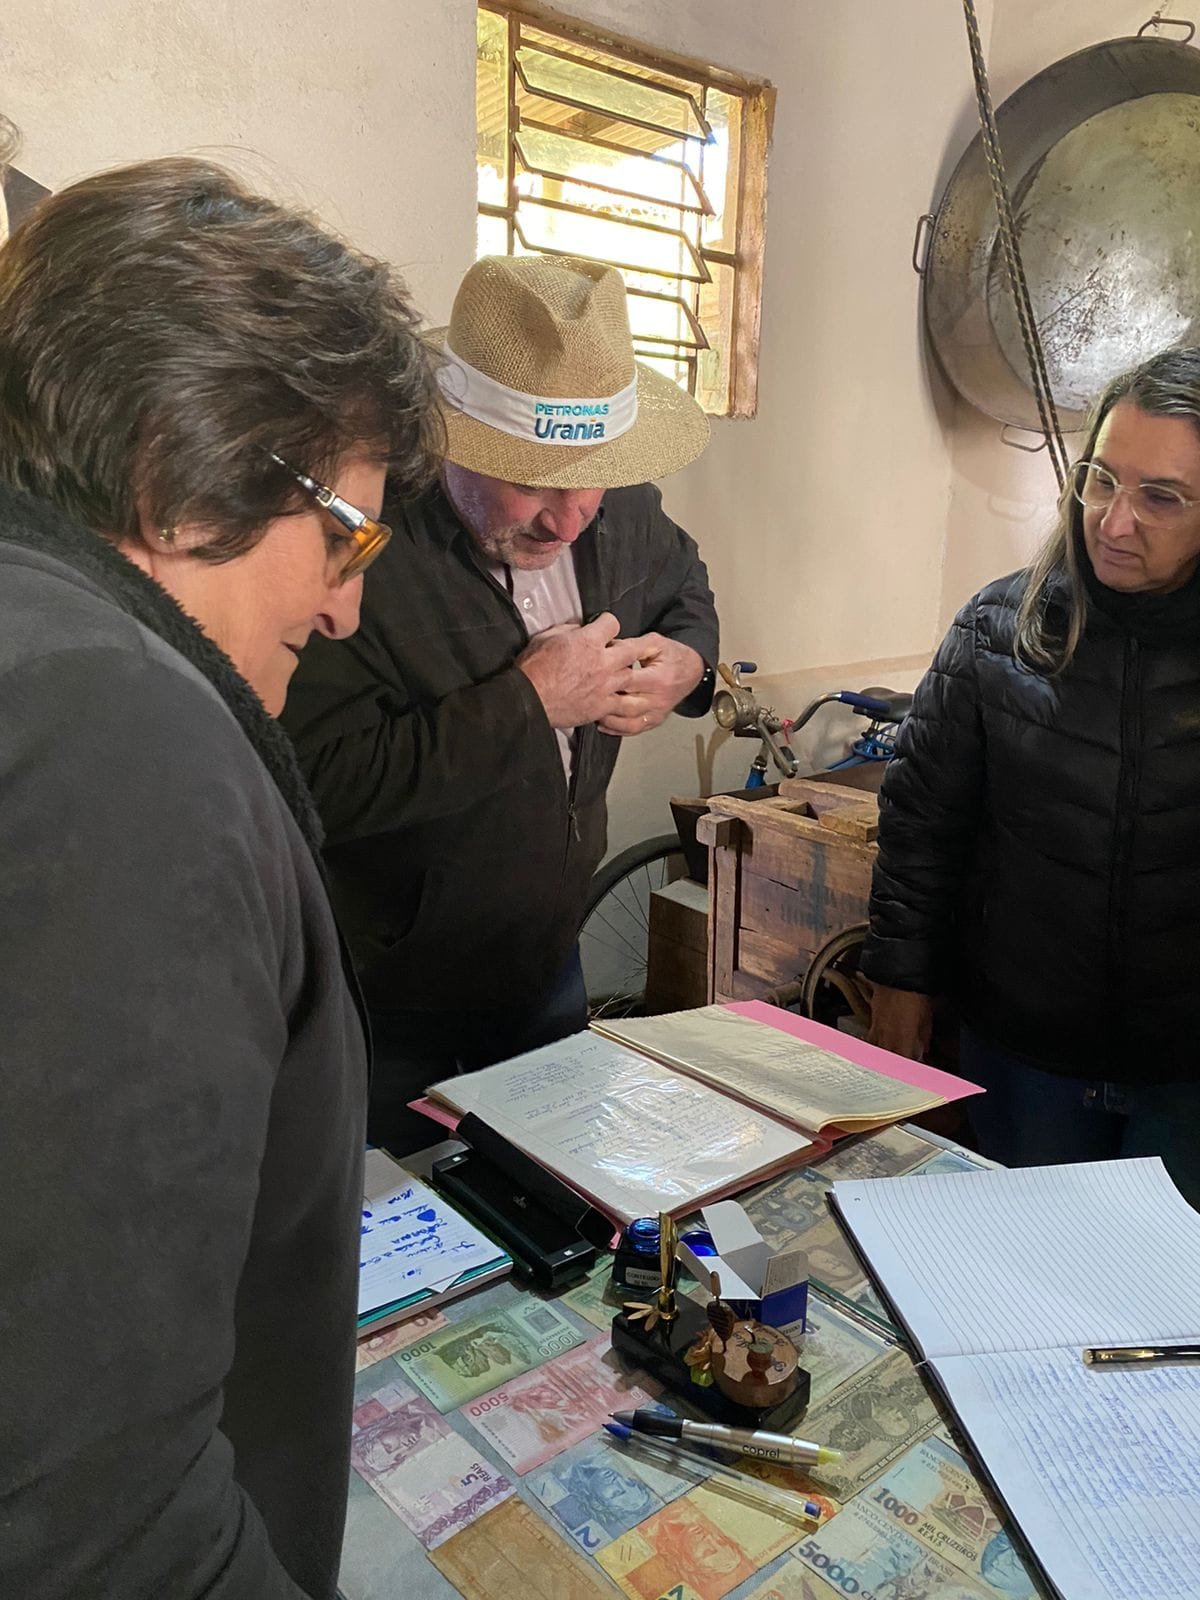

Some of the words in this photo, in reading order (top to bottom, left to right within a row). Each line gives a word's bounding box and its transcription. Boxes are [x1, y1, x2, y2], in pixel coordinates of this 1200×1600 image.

[535, 403, 609, 416] PETRONAS
[534, 417, 605, 440] Urania
[401, 1340, 436, 1362] 1000
[469, 1392, 510, 1418] 5000
[742, 1444, 780, 1459] coprel
[461, 1473, 479, 1486] 5
[470, 1462, 493, 1484] REAIS
[872, 1487, 919, 1526] 1000
[575, 1525, 600, 1548] 2
[916, 1526, 943, 1548] REAIS
[921, 1520, 937, 1537] MIL
[936, 1530, 978, 1562] CRUZEIROS
[799, 1540, 860, 1594] 5000
